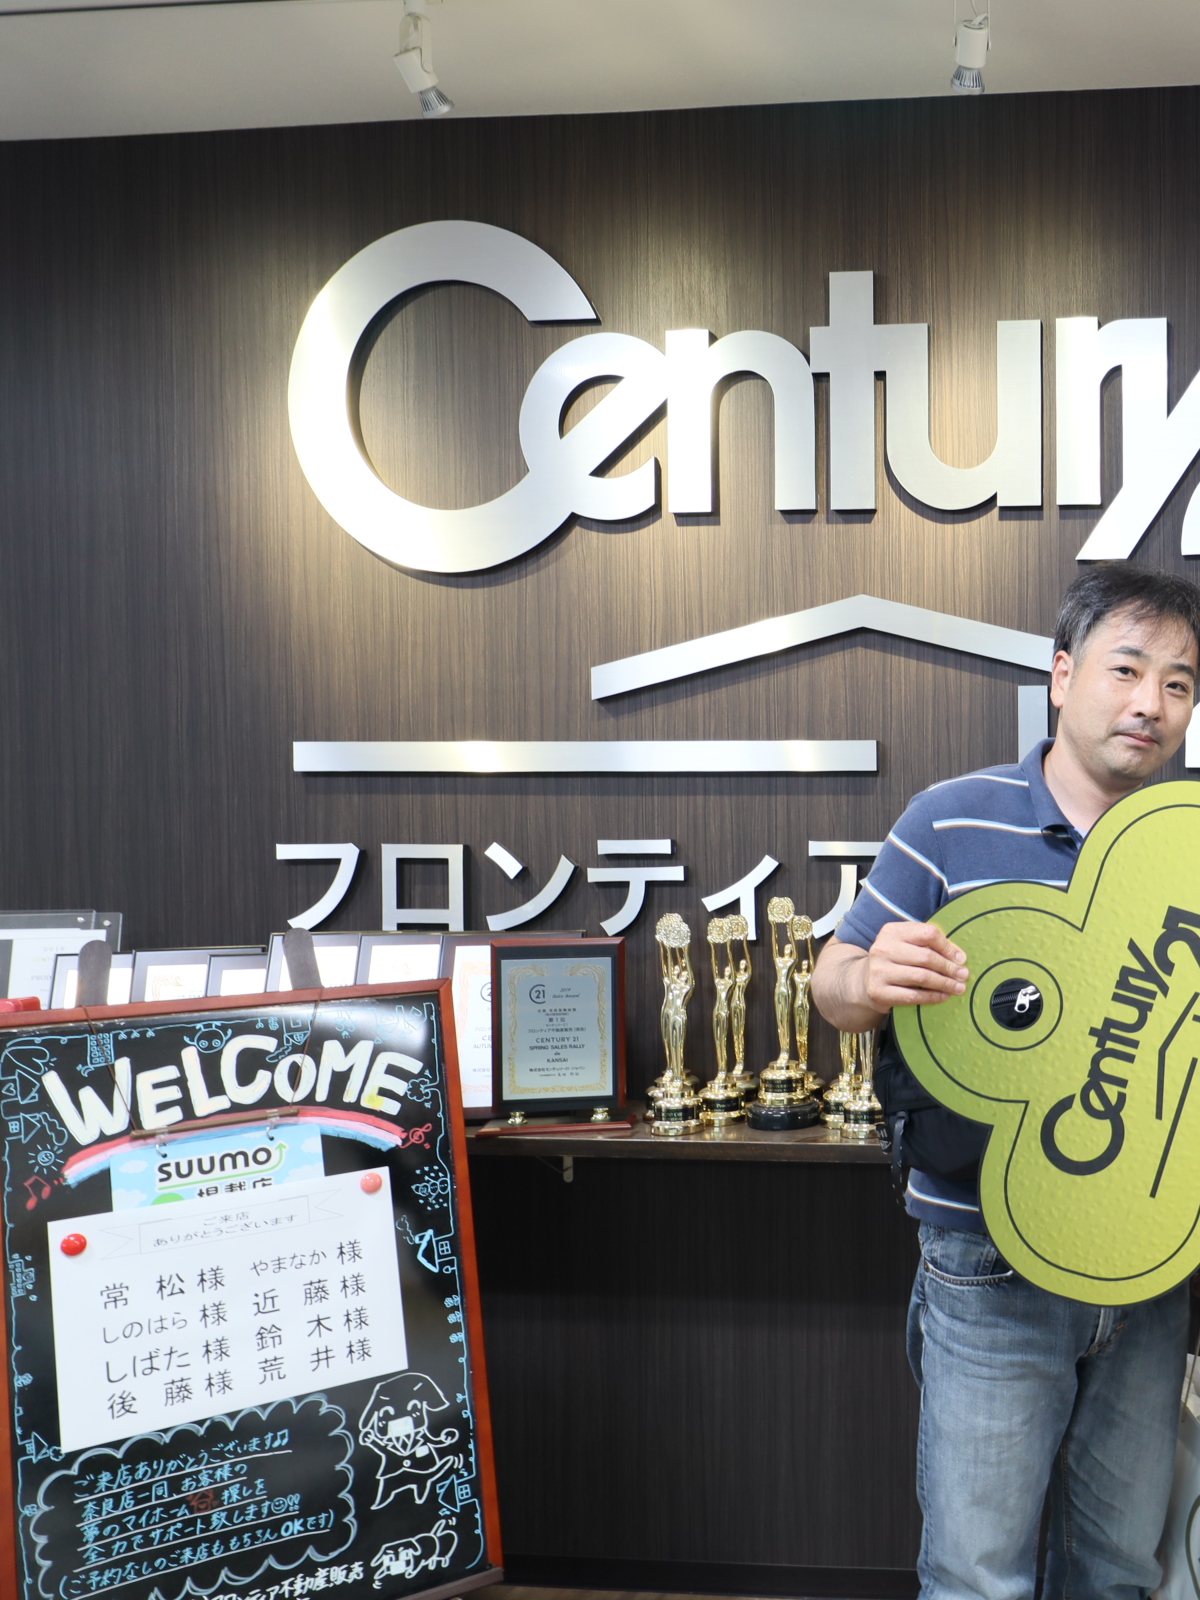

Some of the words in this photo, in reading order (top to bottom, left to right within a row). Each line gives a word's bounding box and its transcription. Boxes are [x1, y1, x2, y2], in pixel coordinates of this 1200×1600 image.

[41, 1034, 425, 1147] WELCOME
[1039, 937, 1170, 1176] Century
[153, 1214, 298, 1248] ありがとうございます
[203, 1211, 250, 1226] ご来店
